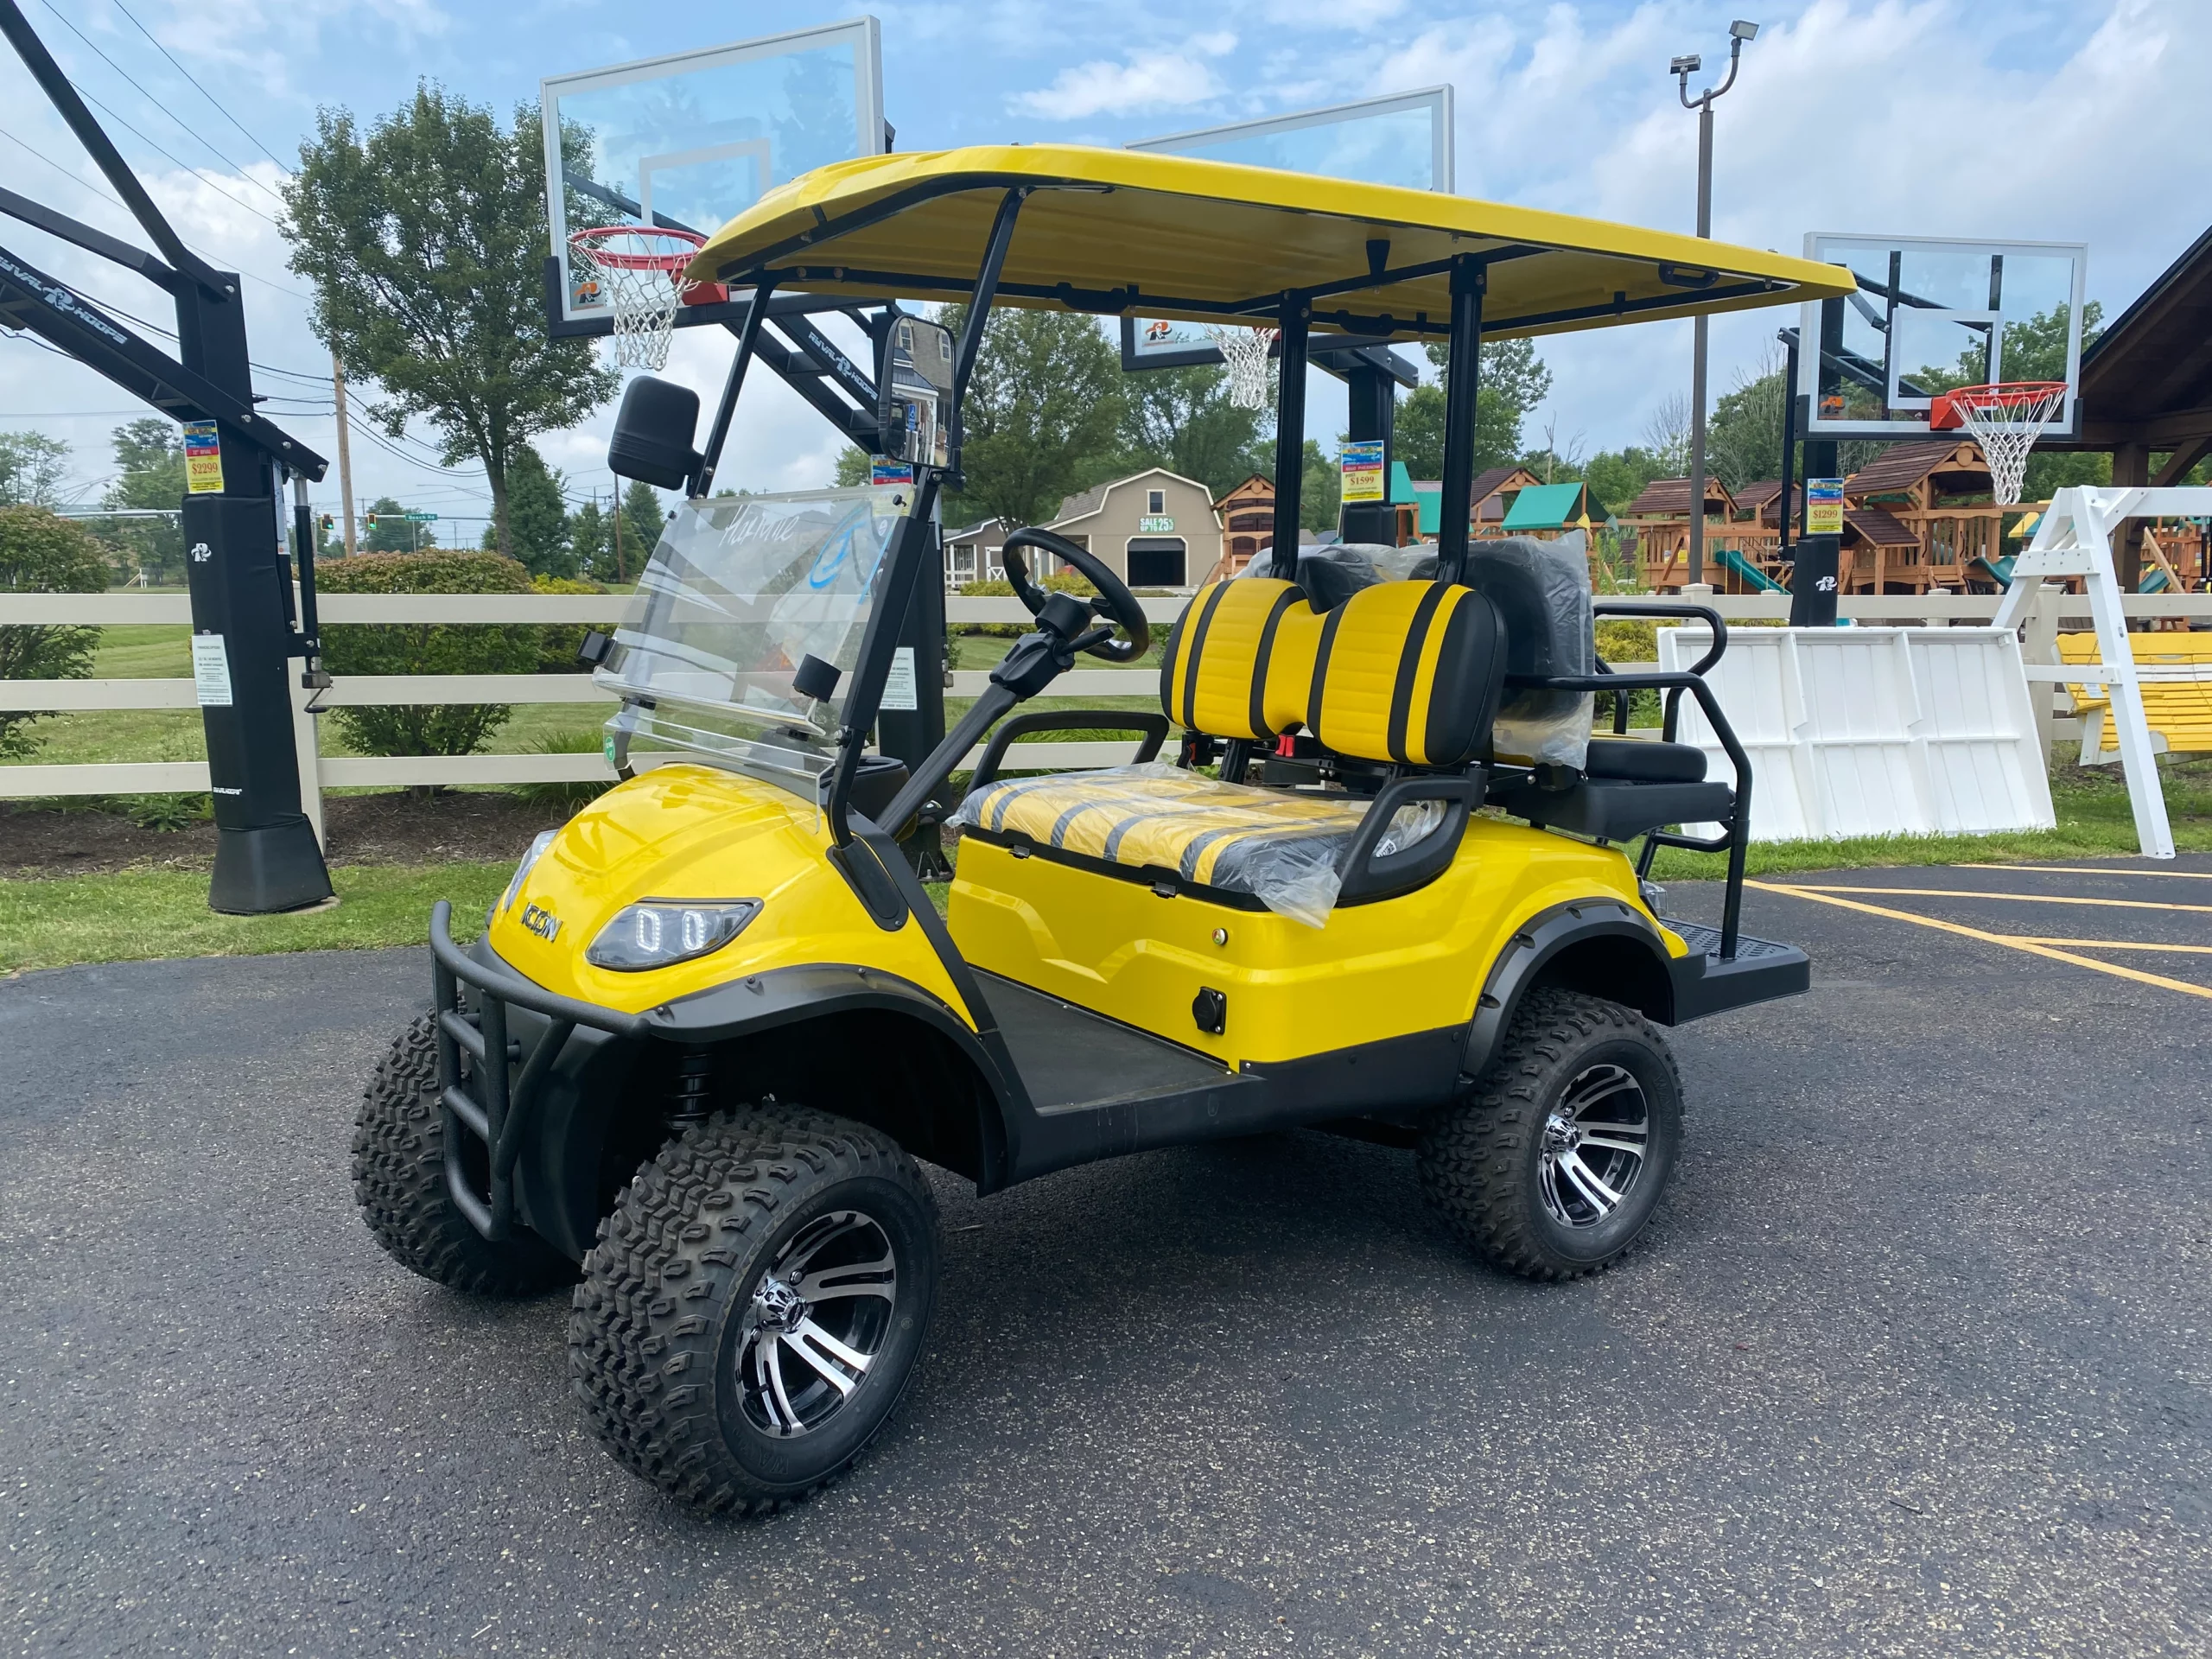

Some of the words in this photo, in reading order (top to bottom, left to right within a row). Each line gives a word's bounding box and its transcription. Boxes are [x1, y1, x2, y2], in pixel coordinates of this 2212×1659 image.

[73, 308, 128, 344] HOOPS
[850, 372, 878, 400] HOOPS
[192, 462, 218, 474] $2299
[1351, 476, 1374, 485] $1599
[1813, 510, 1838, 519] $1299
[1140, 518, 1158, 526] SALE
[520, 901, 563, 944] ICON
